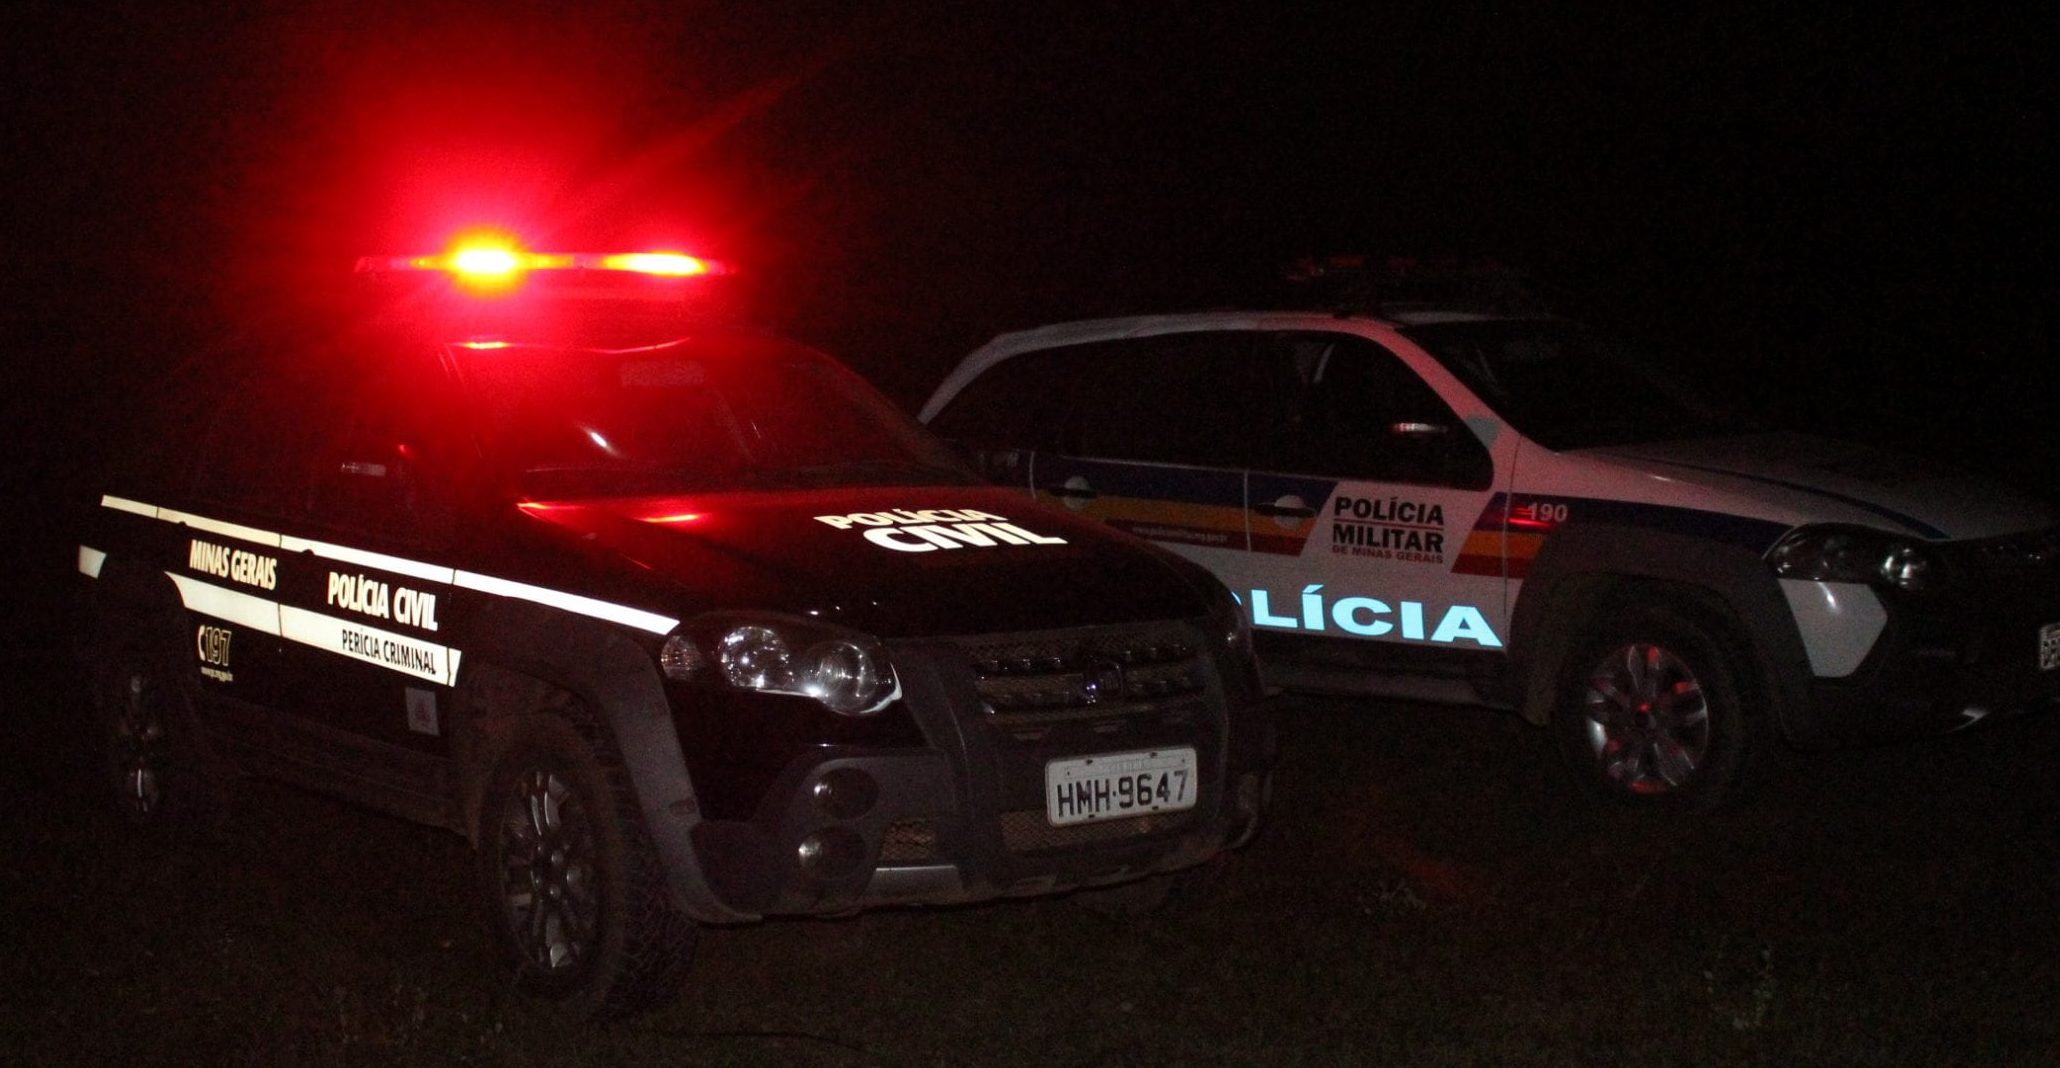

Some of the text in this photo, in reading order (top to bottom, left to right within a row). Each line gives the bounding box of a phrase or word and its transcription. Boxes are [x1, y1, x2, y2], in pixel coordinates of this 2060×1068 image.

[813, 508, 1008, 530] POLÍCIA
[1334, 496, 1444, 525] POLÍCIA
[1528, 502, 1569, 523] 190
[863, 522, 1068, 552] CIVIL
[1333, 523, 1444, 553] MILITAR
[189, 539, 277, 590] MINAS GERAIS
[1332, 544, 1443, 564] DE MINAS GERAIS
[327, 571, 438, 631] POLÍCIA CIVIL
[1231, 584, 1503, 647] LÍCIA
[342, 628, 436, 675] PERÍCIA CRIMINAL
